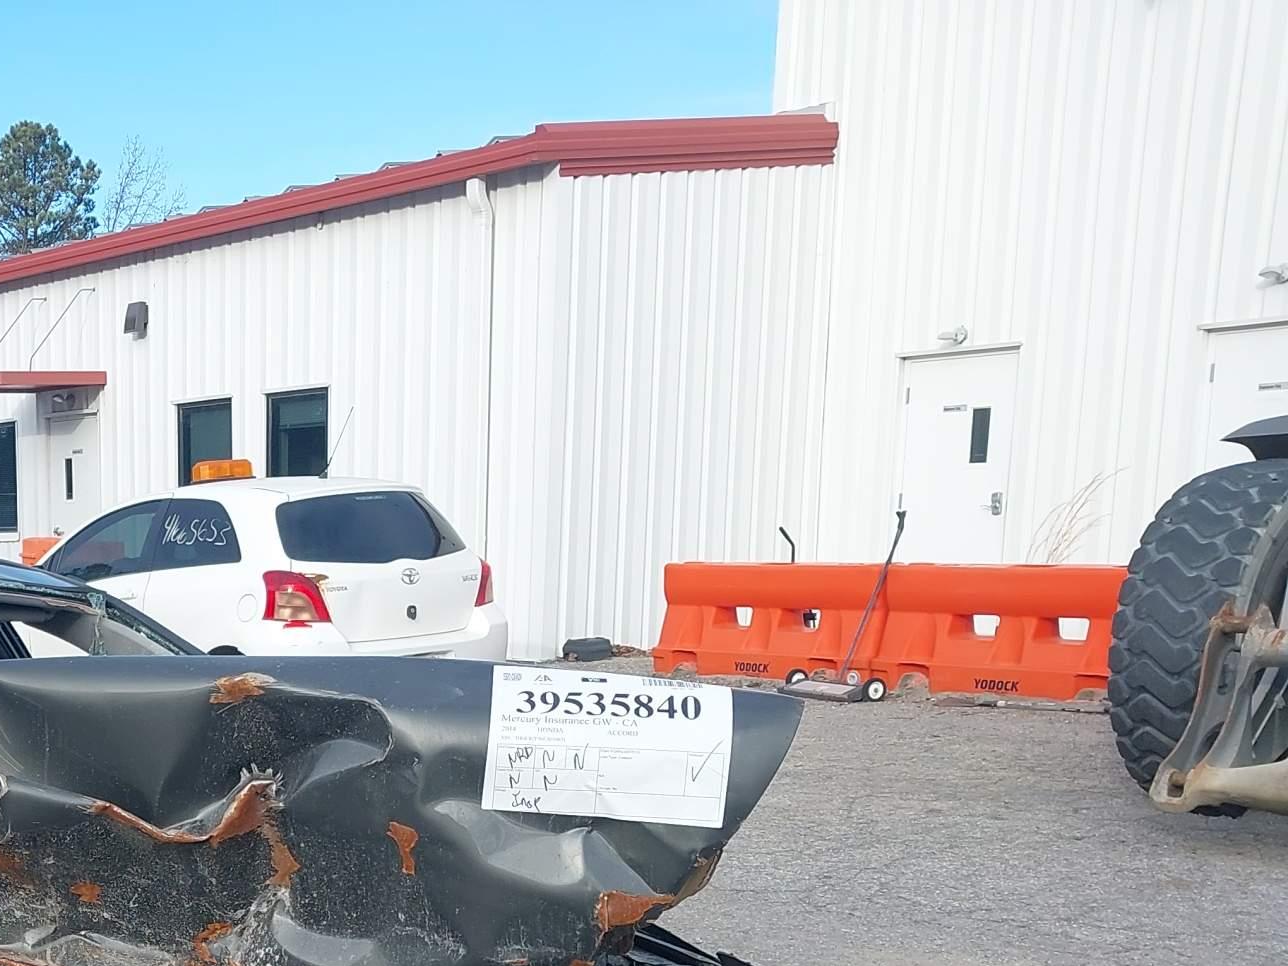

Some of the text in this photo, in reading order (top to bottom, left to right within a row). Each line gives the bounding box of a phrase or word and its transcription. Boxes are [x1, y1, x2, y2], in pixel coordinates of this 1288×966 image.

[734, 661, 770, 673] YODOCK
[973, 678, 1020, 692] YODOCK
[516, 690, 702, 720] 39535840
[501, 714, 541, 726] Mercury
[544, 715, 590, 726] Insurance
[592, 717, 612, 727] GW
[622, 719, 639, 728] CA
[607, 729, 639, 737] ACCORD
